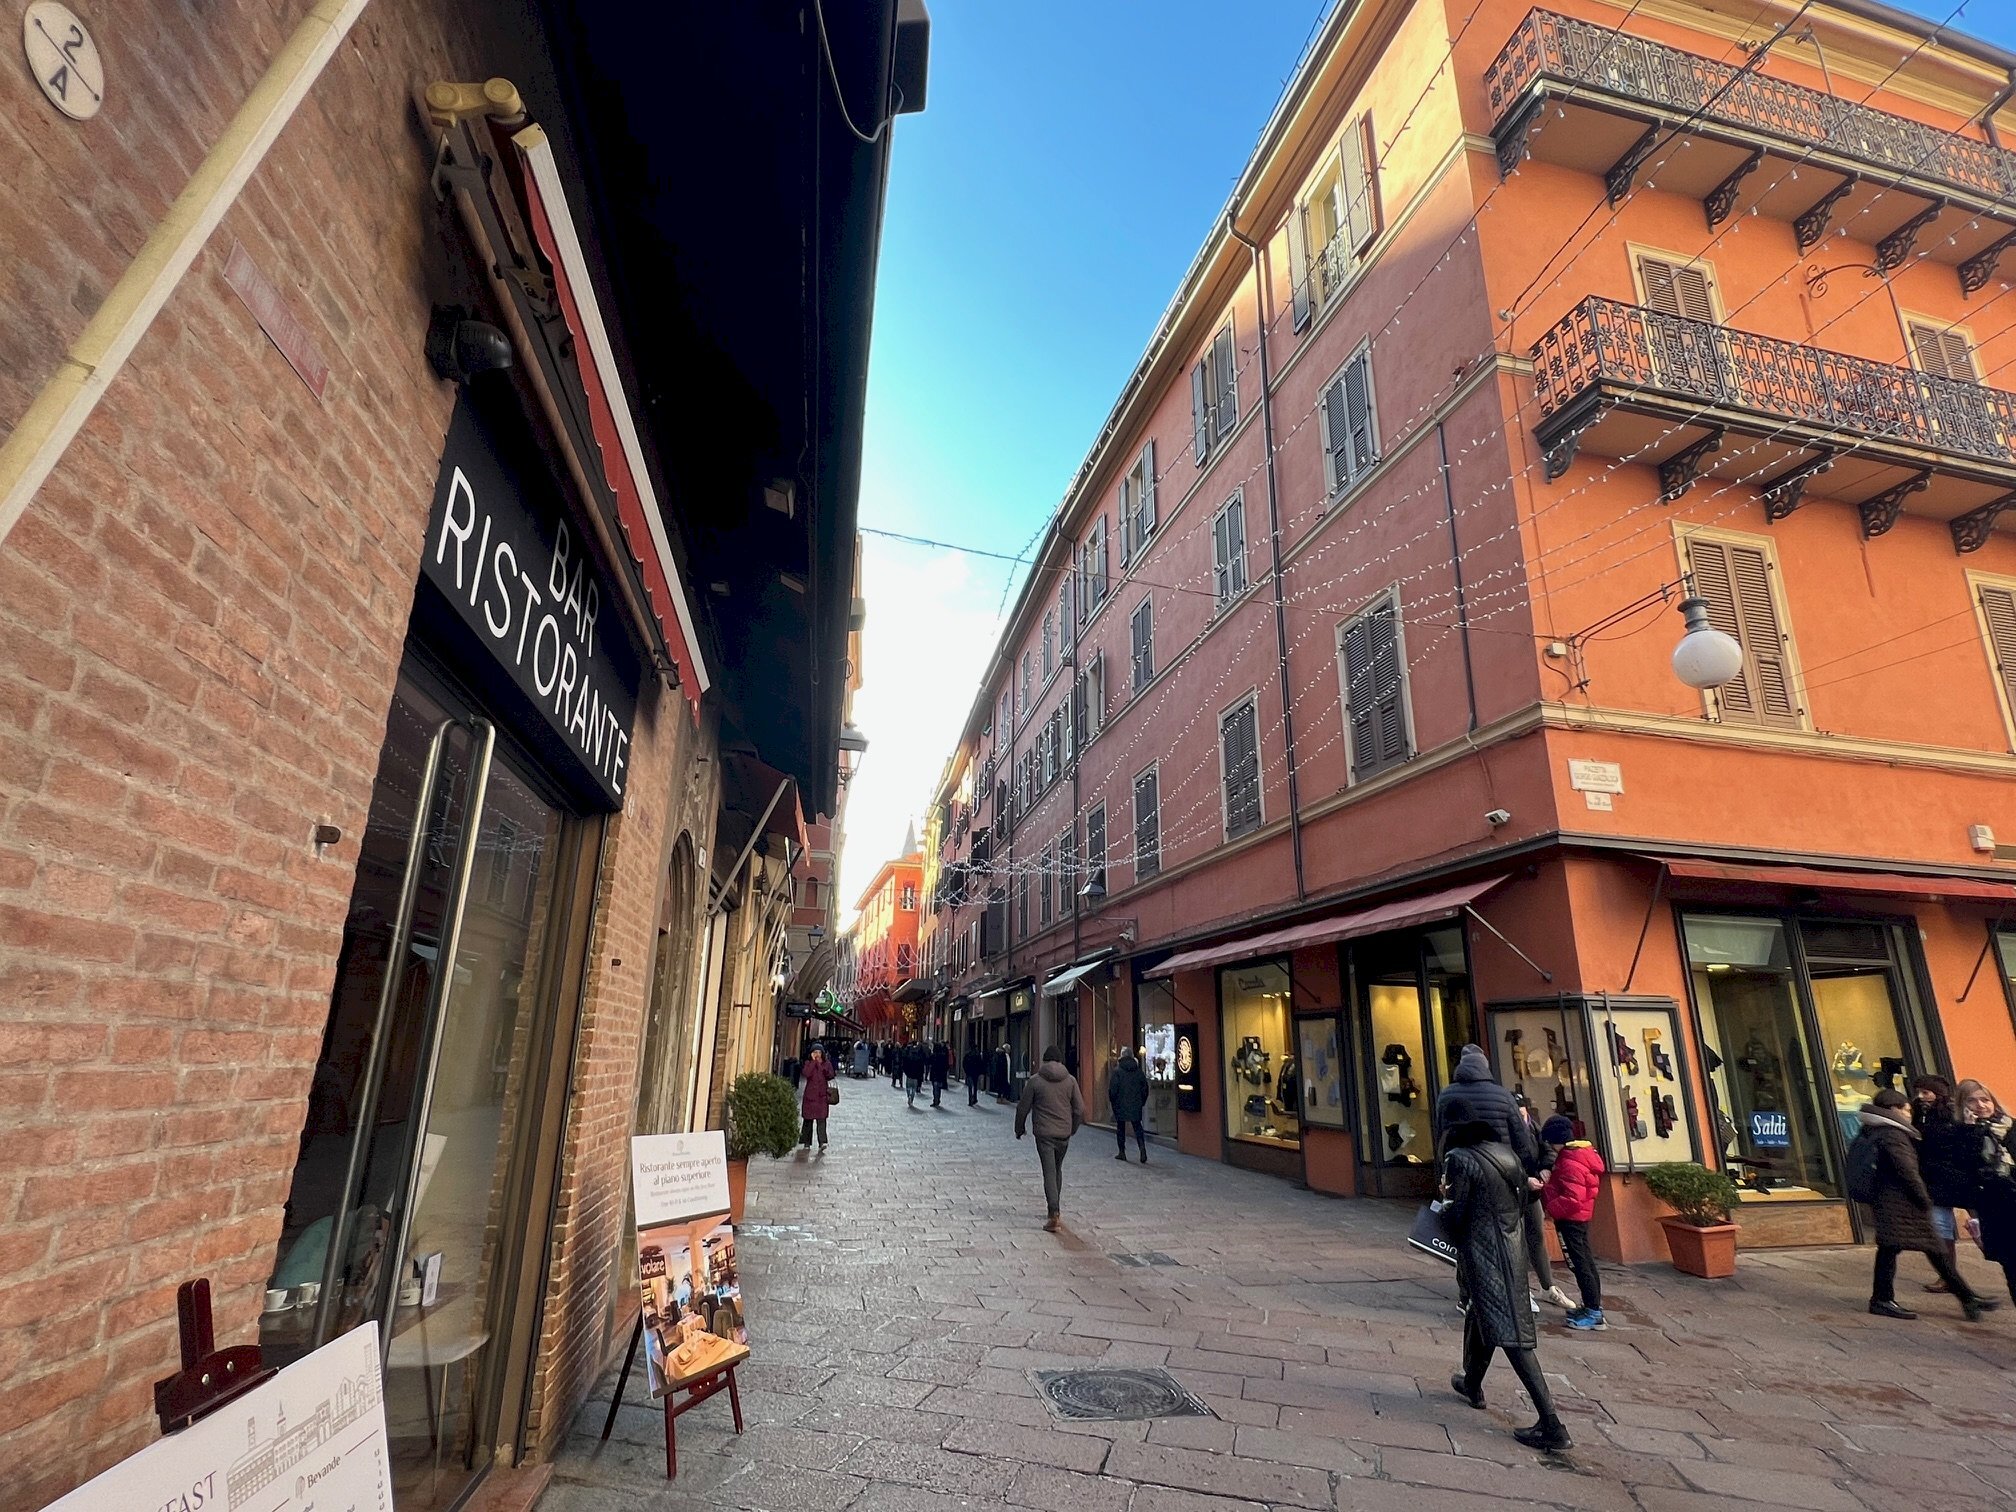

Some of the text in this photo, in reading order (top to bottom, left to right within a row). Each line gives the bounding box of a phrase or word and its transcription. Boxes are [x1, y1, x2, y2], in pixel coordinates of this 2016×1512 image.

[63, 24, 83, 64] 2
[49, 64, 68, 101] A
[549, 518, 599, 658] BAR
[436, 465, 629, 796] RISTORANTE
[1752, 1114, 1787, 1136] Saldi
[640, 1156, 722, 1174] Ristorante sempre aperto
[653, 1169, 711, 1188] al piano superiore
[306, 1456, 341, 1489] Bevande
